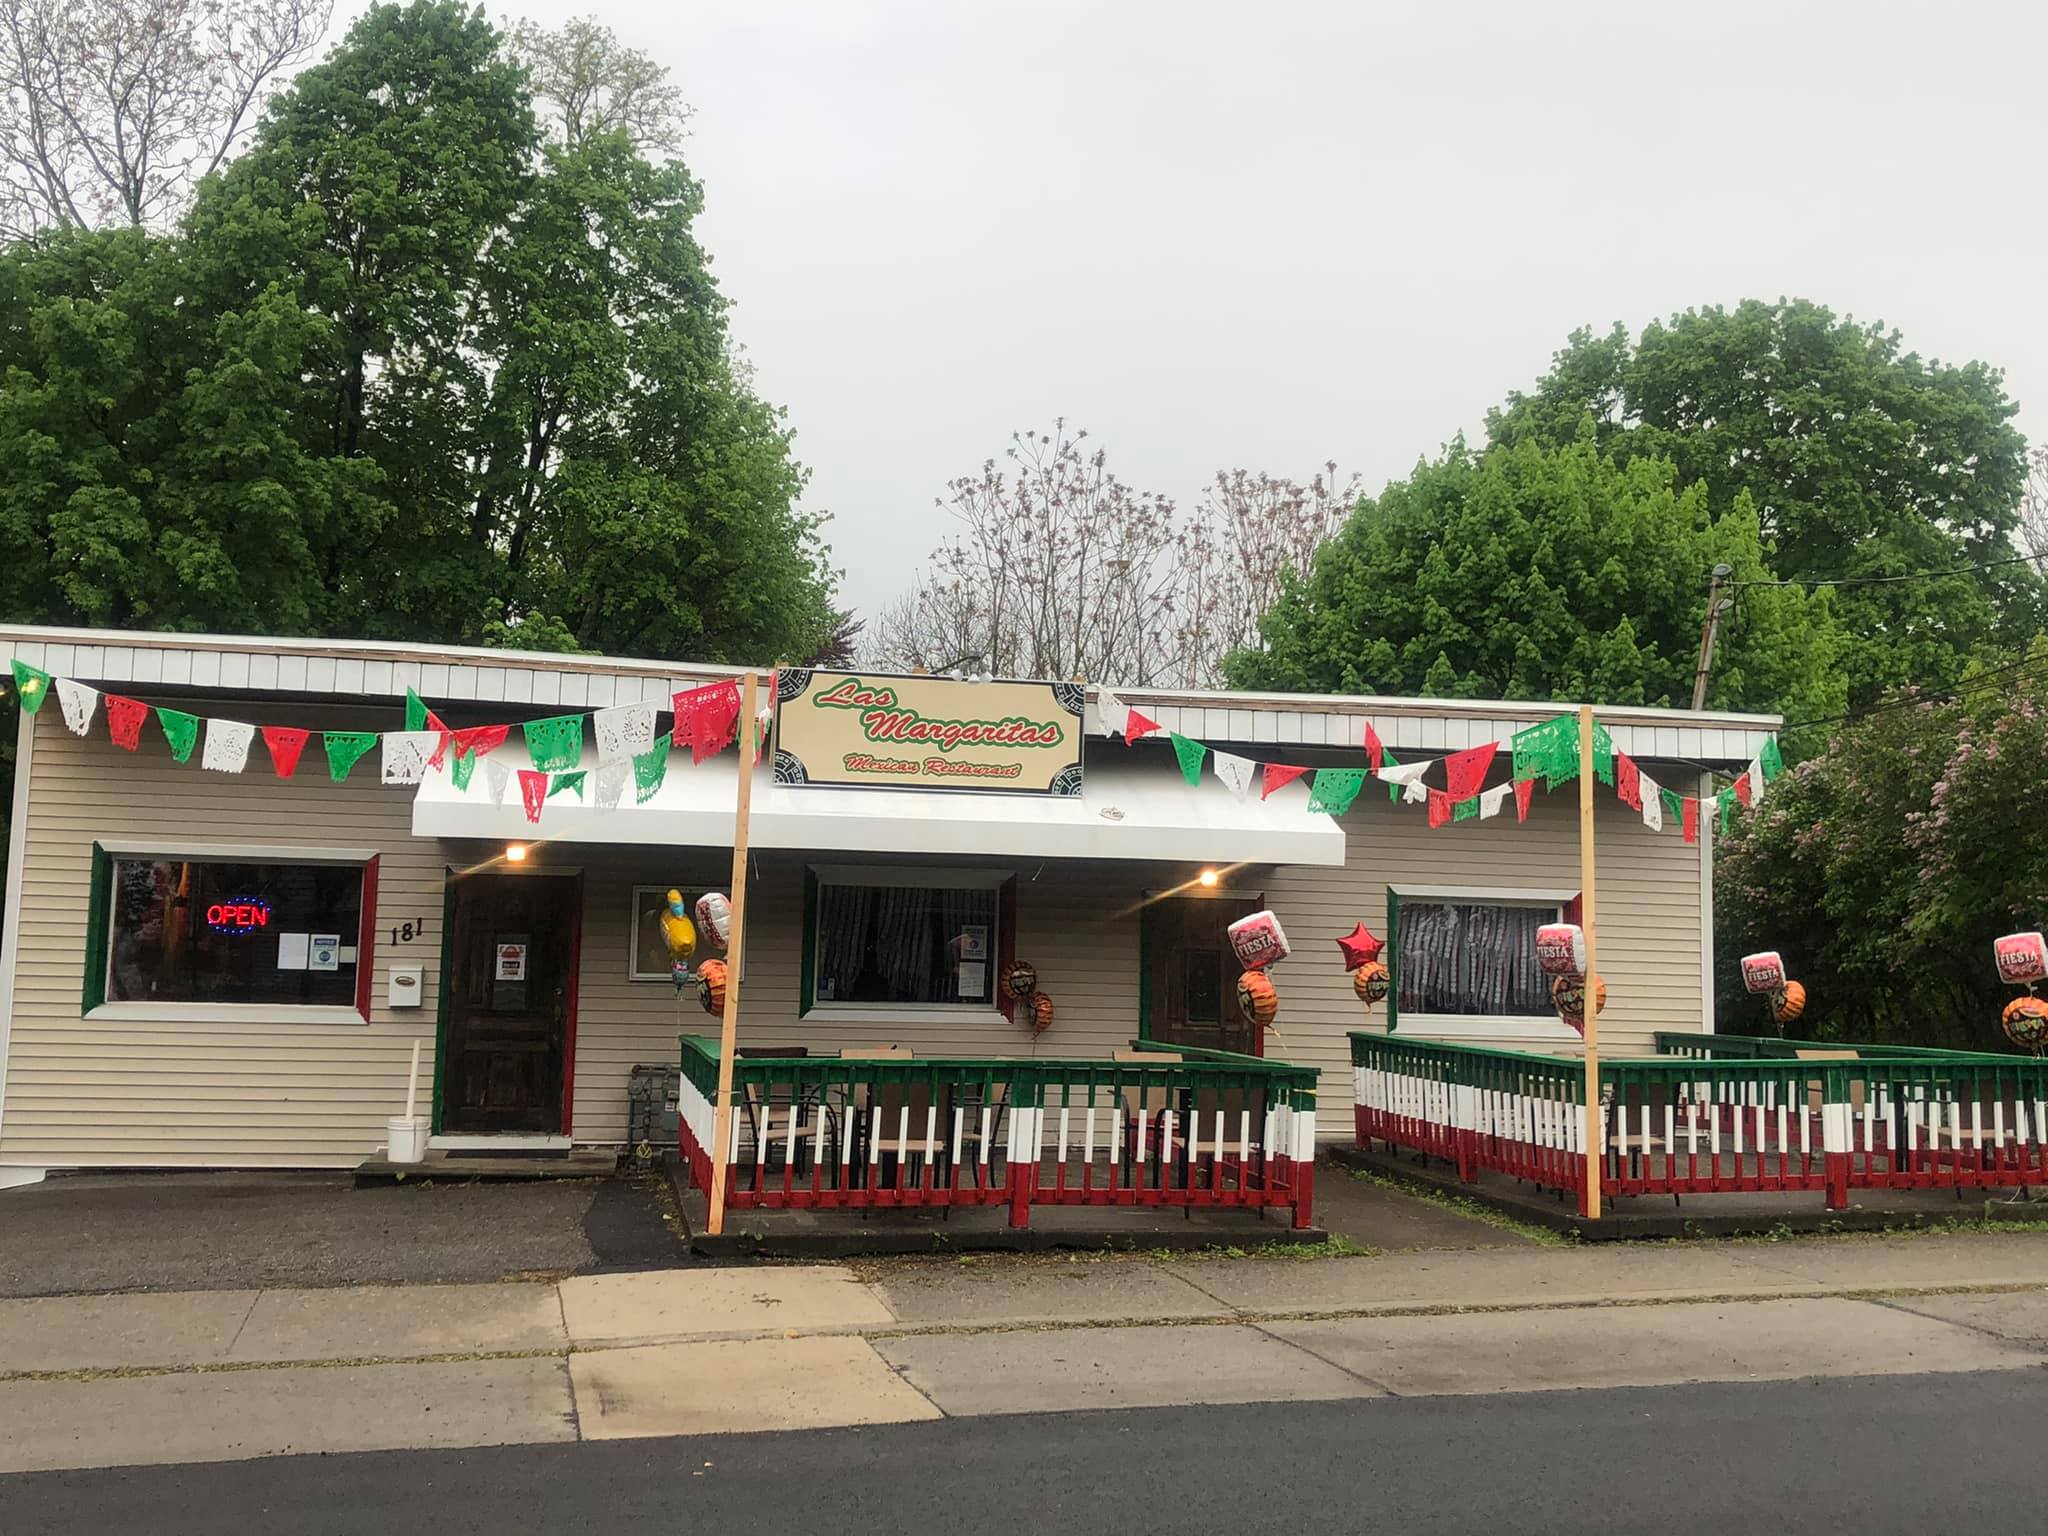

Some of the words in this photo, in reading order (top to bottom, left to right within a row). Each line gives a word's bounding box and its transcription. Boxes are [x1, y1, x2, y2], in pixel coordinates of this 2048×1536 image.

[815, 680, 895, 706] Las
[863, 709, 1060, 748] Margaritas
[844, 755, 919, 774] Mexican
[924, 758, 1020, 779] Restaurant
[207, 904, 267, 926] OPEN
[391, 917, 422, 947] 181
[1236, 934, 1276, 958] FIESTA
[1999, 950, 2038, 966] FIESTA
[1747, 969, 1779, 981] FIESTA
